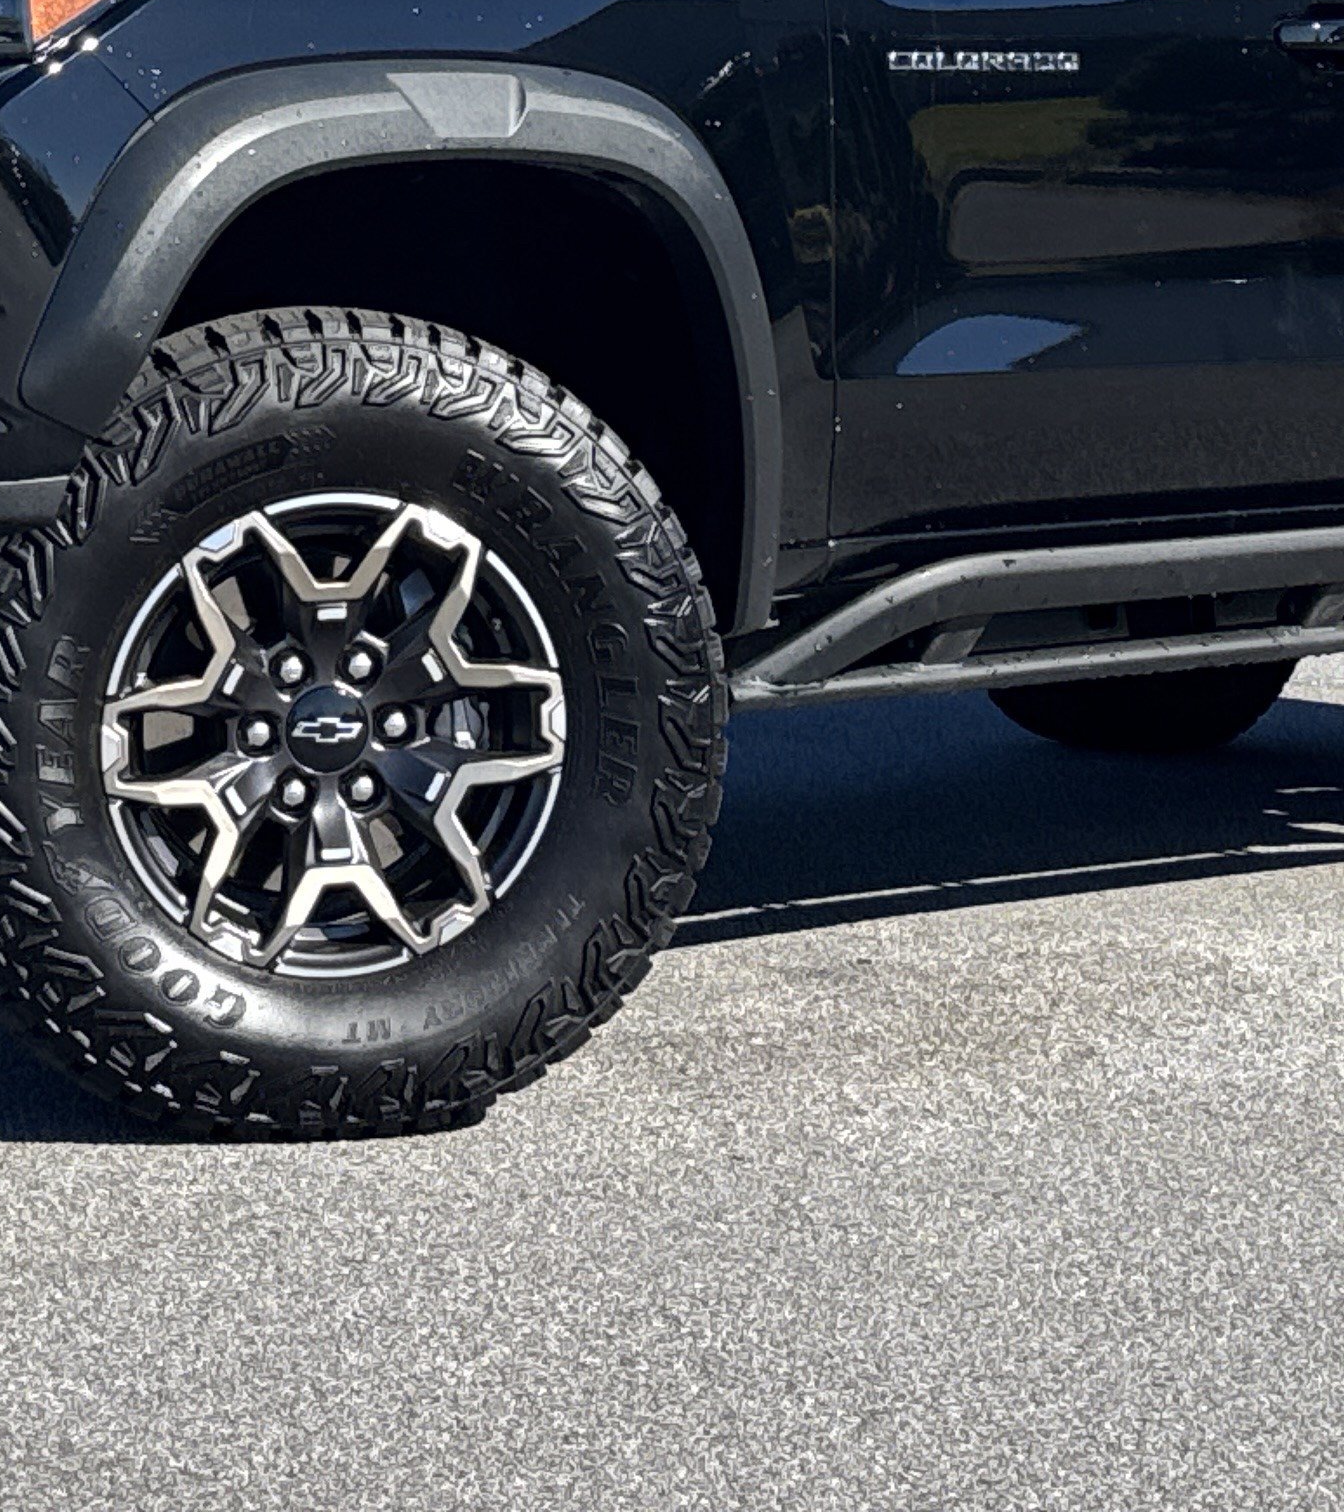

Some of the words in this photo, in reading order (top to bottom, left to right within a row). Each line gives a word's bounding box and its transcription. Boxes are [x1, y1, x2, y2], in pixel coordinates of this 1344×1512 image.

[887, 50, 1080, 71] COLORADO
[452, 448, 641, 808] WRANGLER
[36, 633, 248, 1030] GOODYEAR
